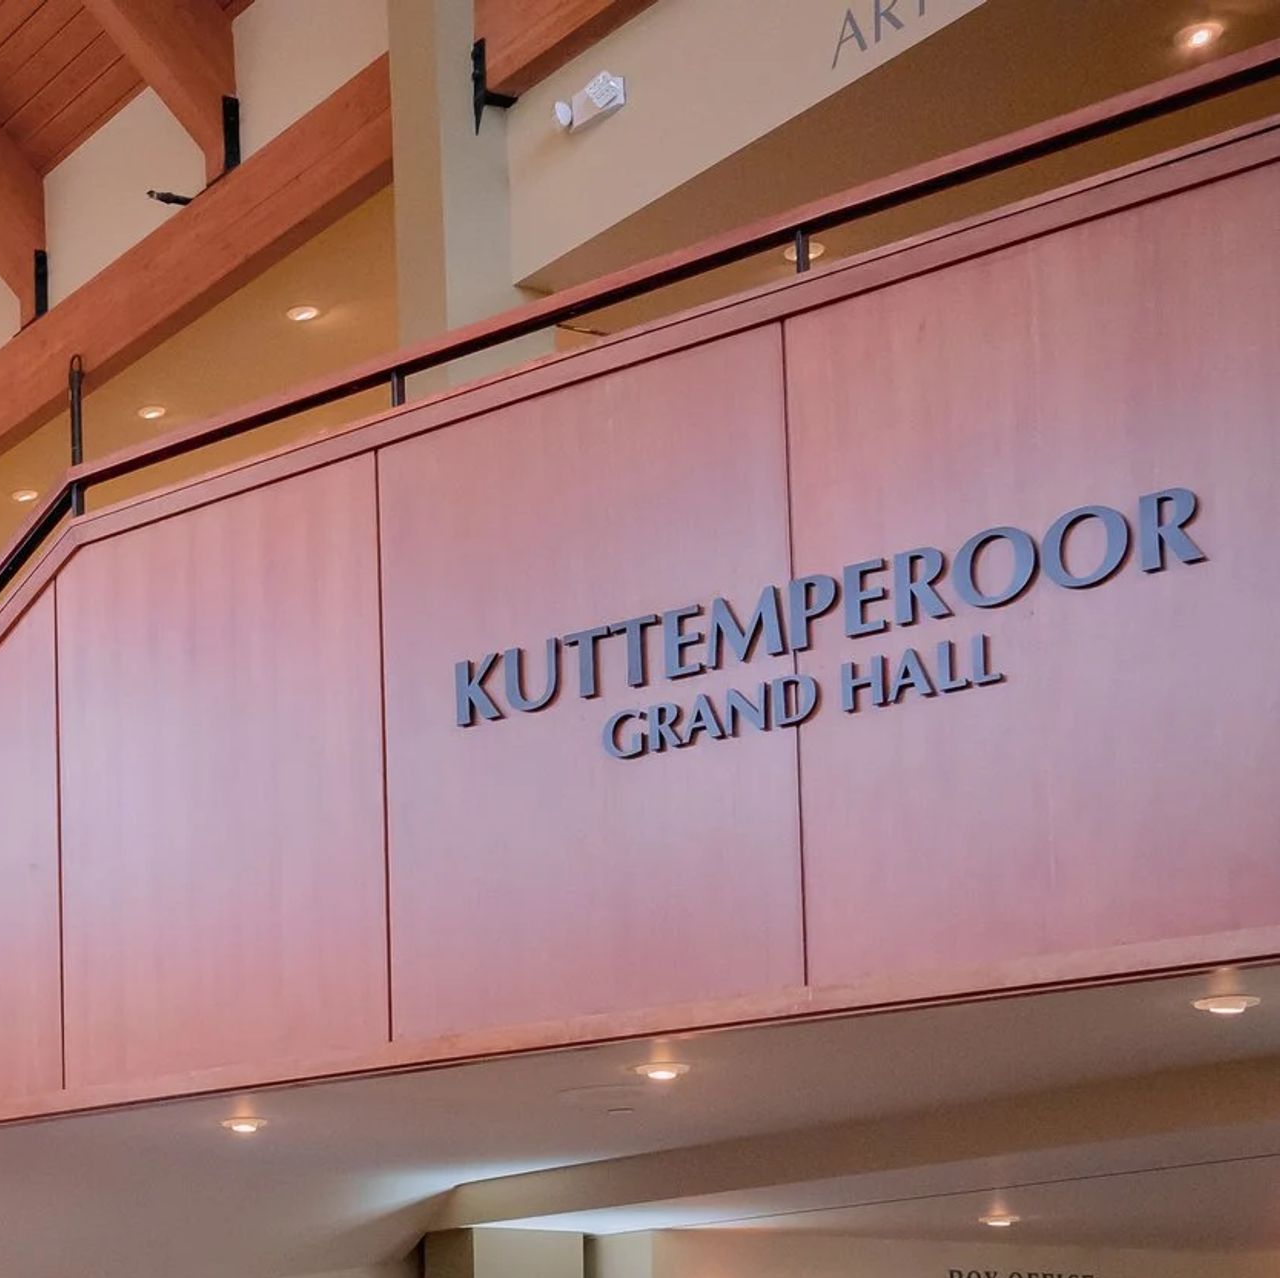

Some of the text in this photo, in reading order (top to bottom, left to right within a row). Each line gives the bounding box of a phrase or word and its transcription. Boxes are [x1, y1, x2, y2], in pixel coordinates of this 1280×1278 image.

[454, 486, 1208, 728] KUTTEMPEROOR
[601, 633, 1007, 760] GRAND HALL
